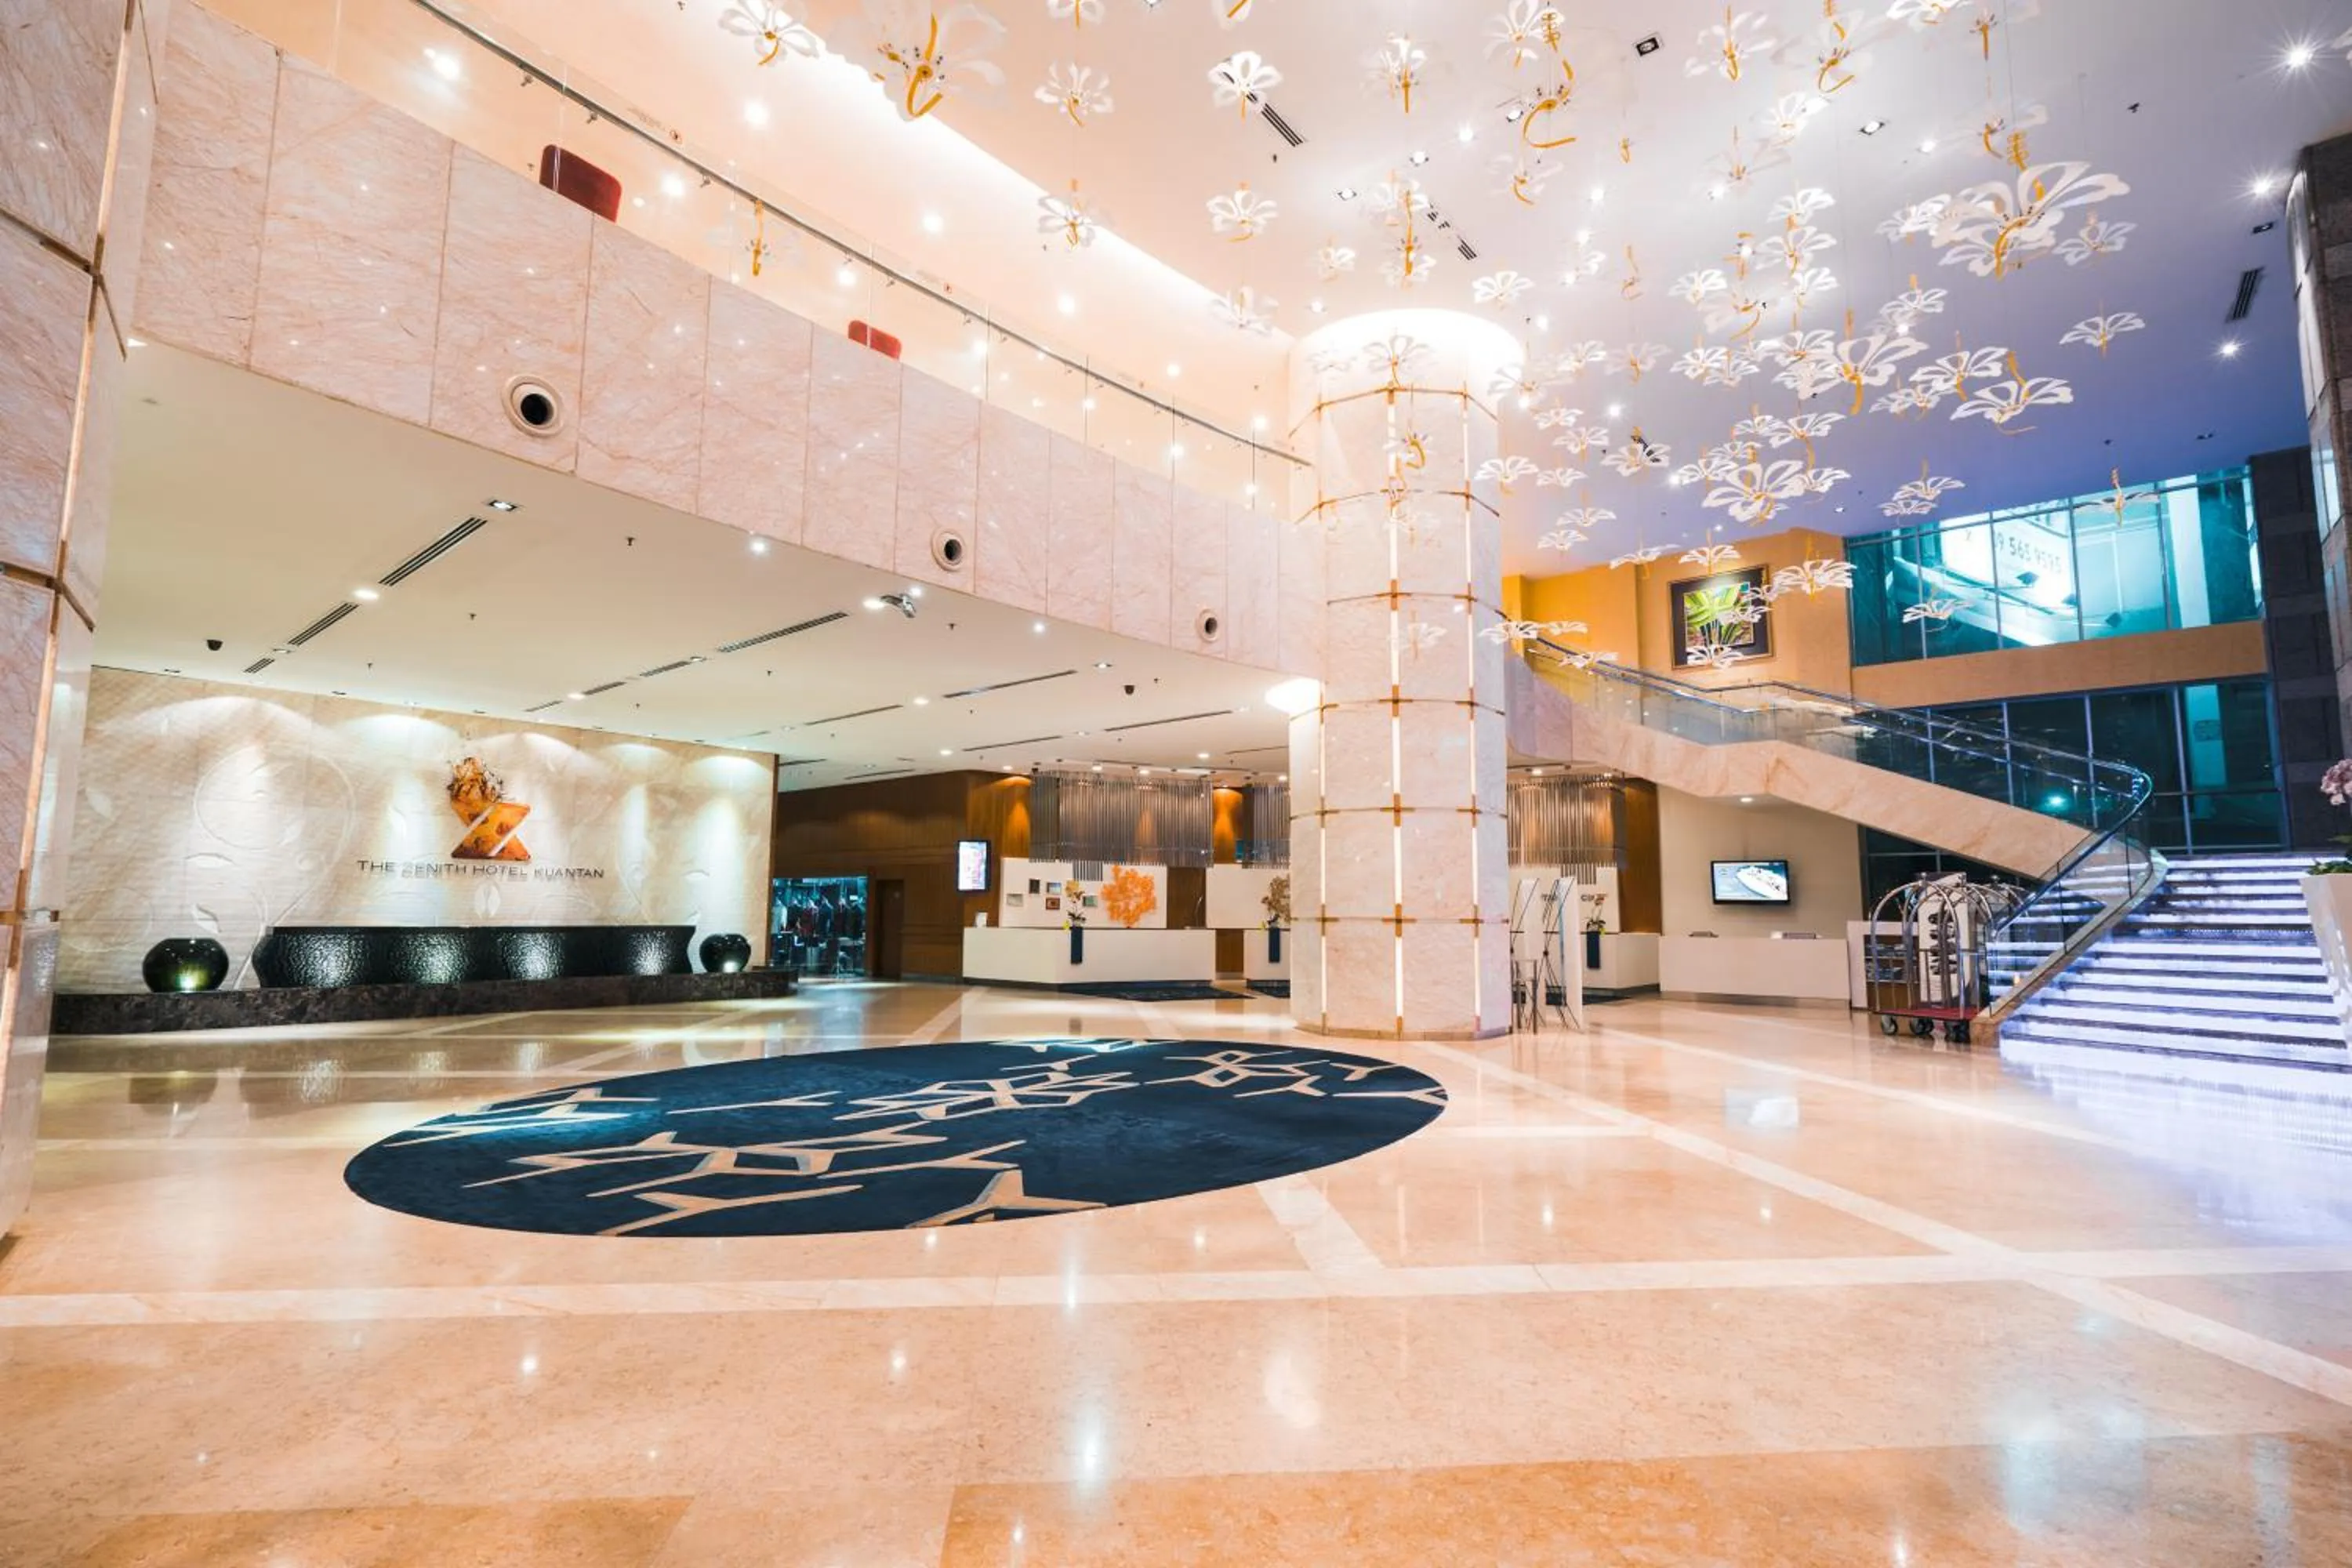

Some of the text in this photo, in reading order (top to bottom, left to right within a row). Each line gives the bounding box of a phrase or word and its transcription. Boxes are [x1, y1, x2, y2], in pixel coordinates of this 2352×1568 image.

[358, 860, 605, 879] THE ZENITH HOTEL KUANTAN
